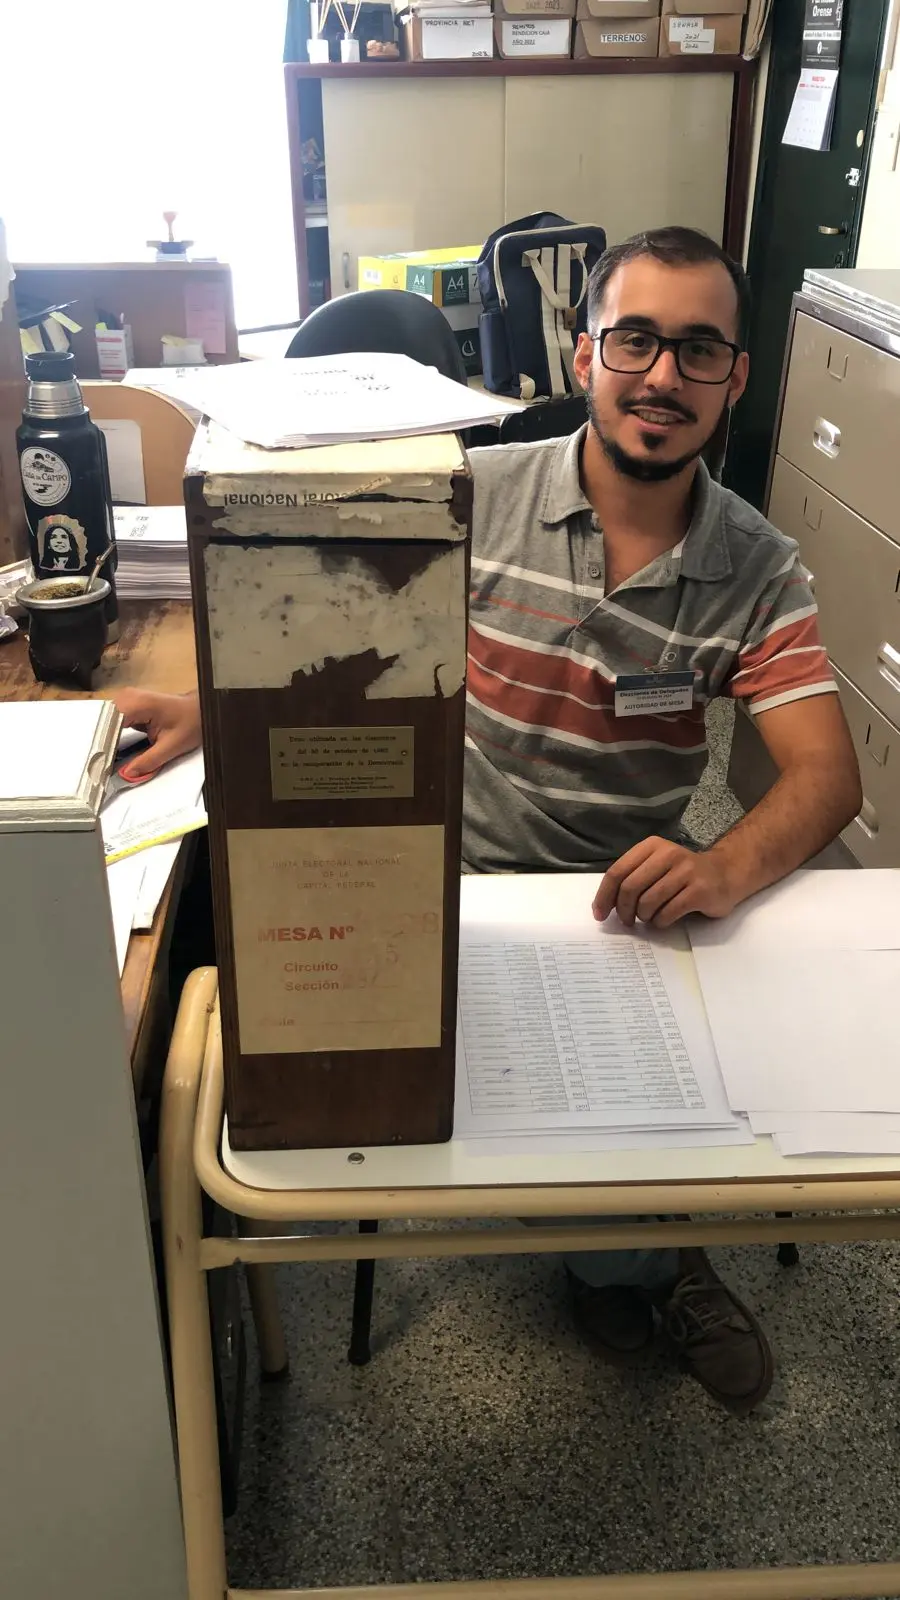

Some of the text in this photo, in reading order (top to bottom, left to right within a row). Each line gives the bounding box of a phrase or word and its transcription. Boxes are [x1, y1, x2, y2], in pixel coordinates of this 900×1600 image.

[812, 5, 833, 16] Orense
[601, 34, 647, 42] TERRENOS
[413, 274, 425, 286] A4
[447, 274, 465, 290] A4
[224, 493, 297, 507] Nacional
[624, 702, 658, 710] AUTORIDAD
[302, 860, 352, 868] ELECTORAL
[357, 858, 401, 867] NACIONAL
[297, 881, 376, 890] CAPITAL FEDERAL
[257, 926, 323, 943] MESA
[283, 961, 338, 973] Circuito
[284, 981, 339, 992] Sección
